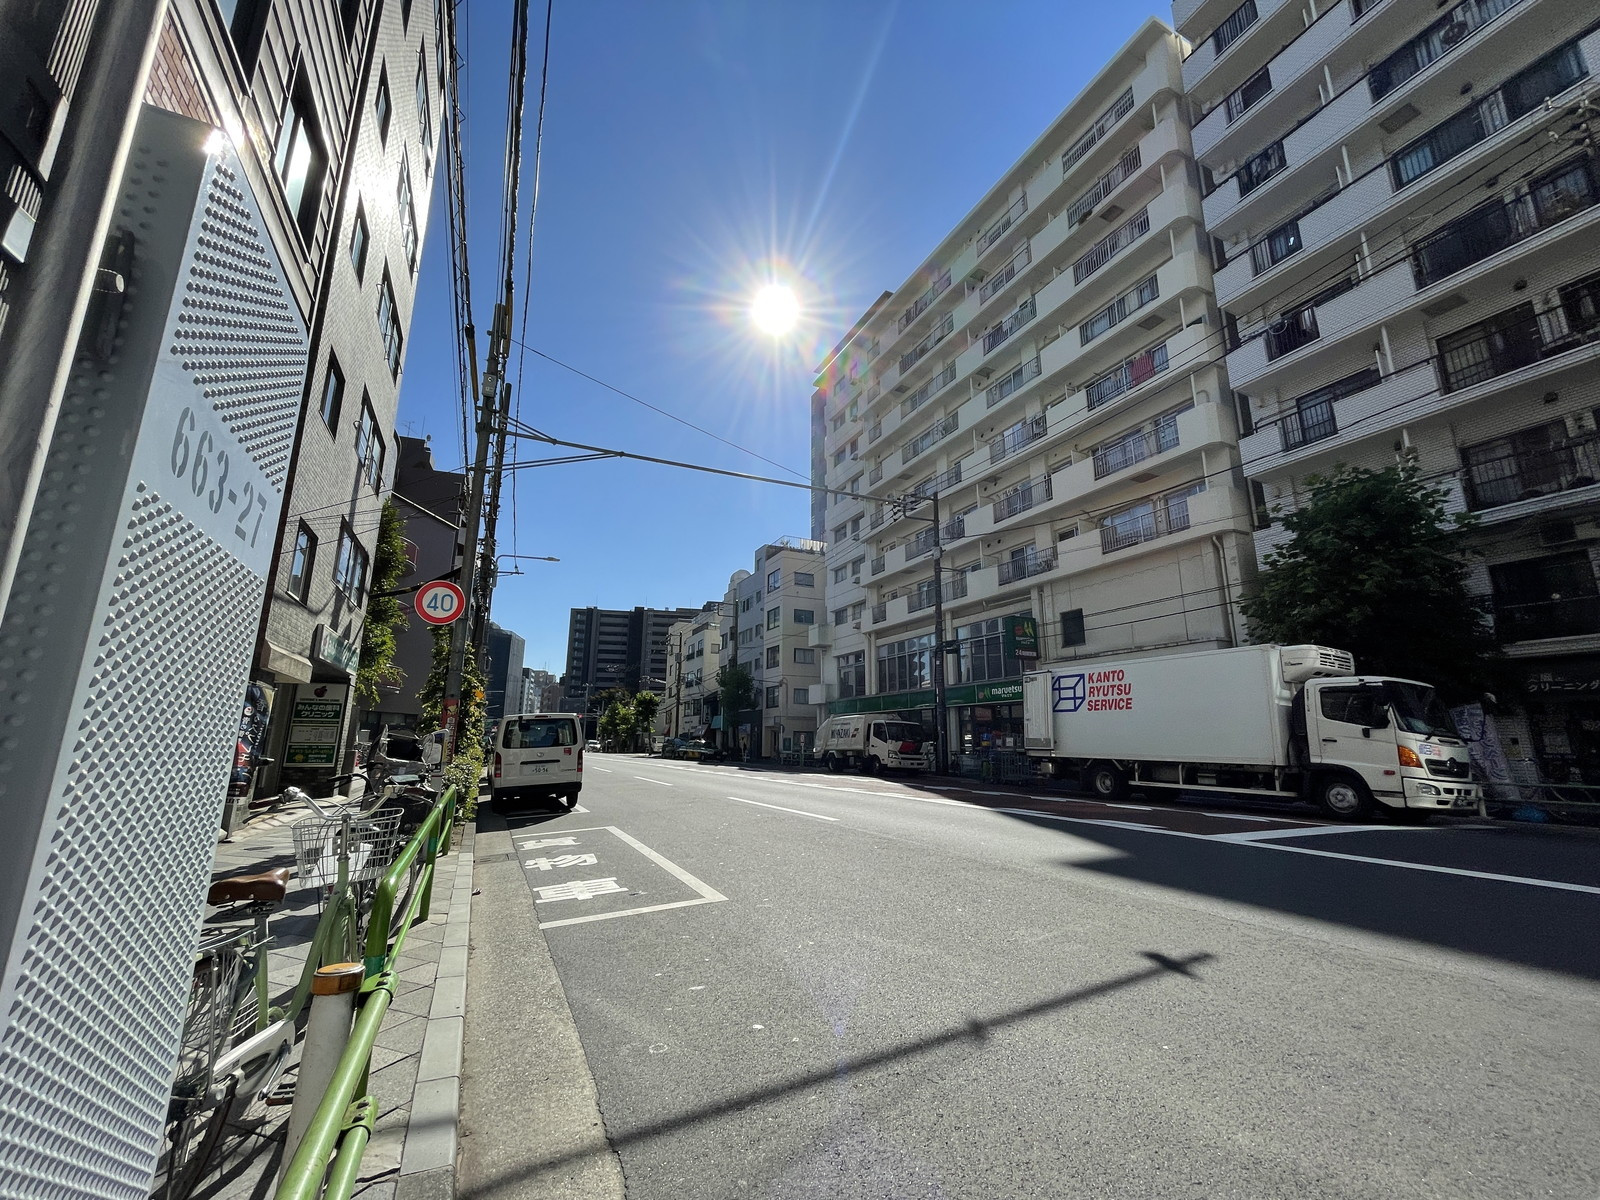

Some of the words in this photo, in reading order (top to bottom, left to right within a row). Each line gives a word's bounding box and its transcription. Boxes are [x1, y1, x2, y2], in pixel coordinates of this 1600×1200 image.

[171, 406, 267, 548] 663-27
[427, 593, 453, 612] 40
[1087, 669, 1125, 684] KANTO
[991, 685, 1022, 695] maruetsu
[1088, 683, 1132, 697] RYUTSU
[1527, 679, 1600, 692] クリーニング
[1087, 698, 1133, 712] SERVICE
